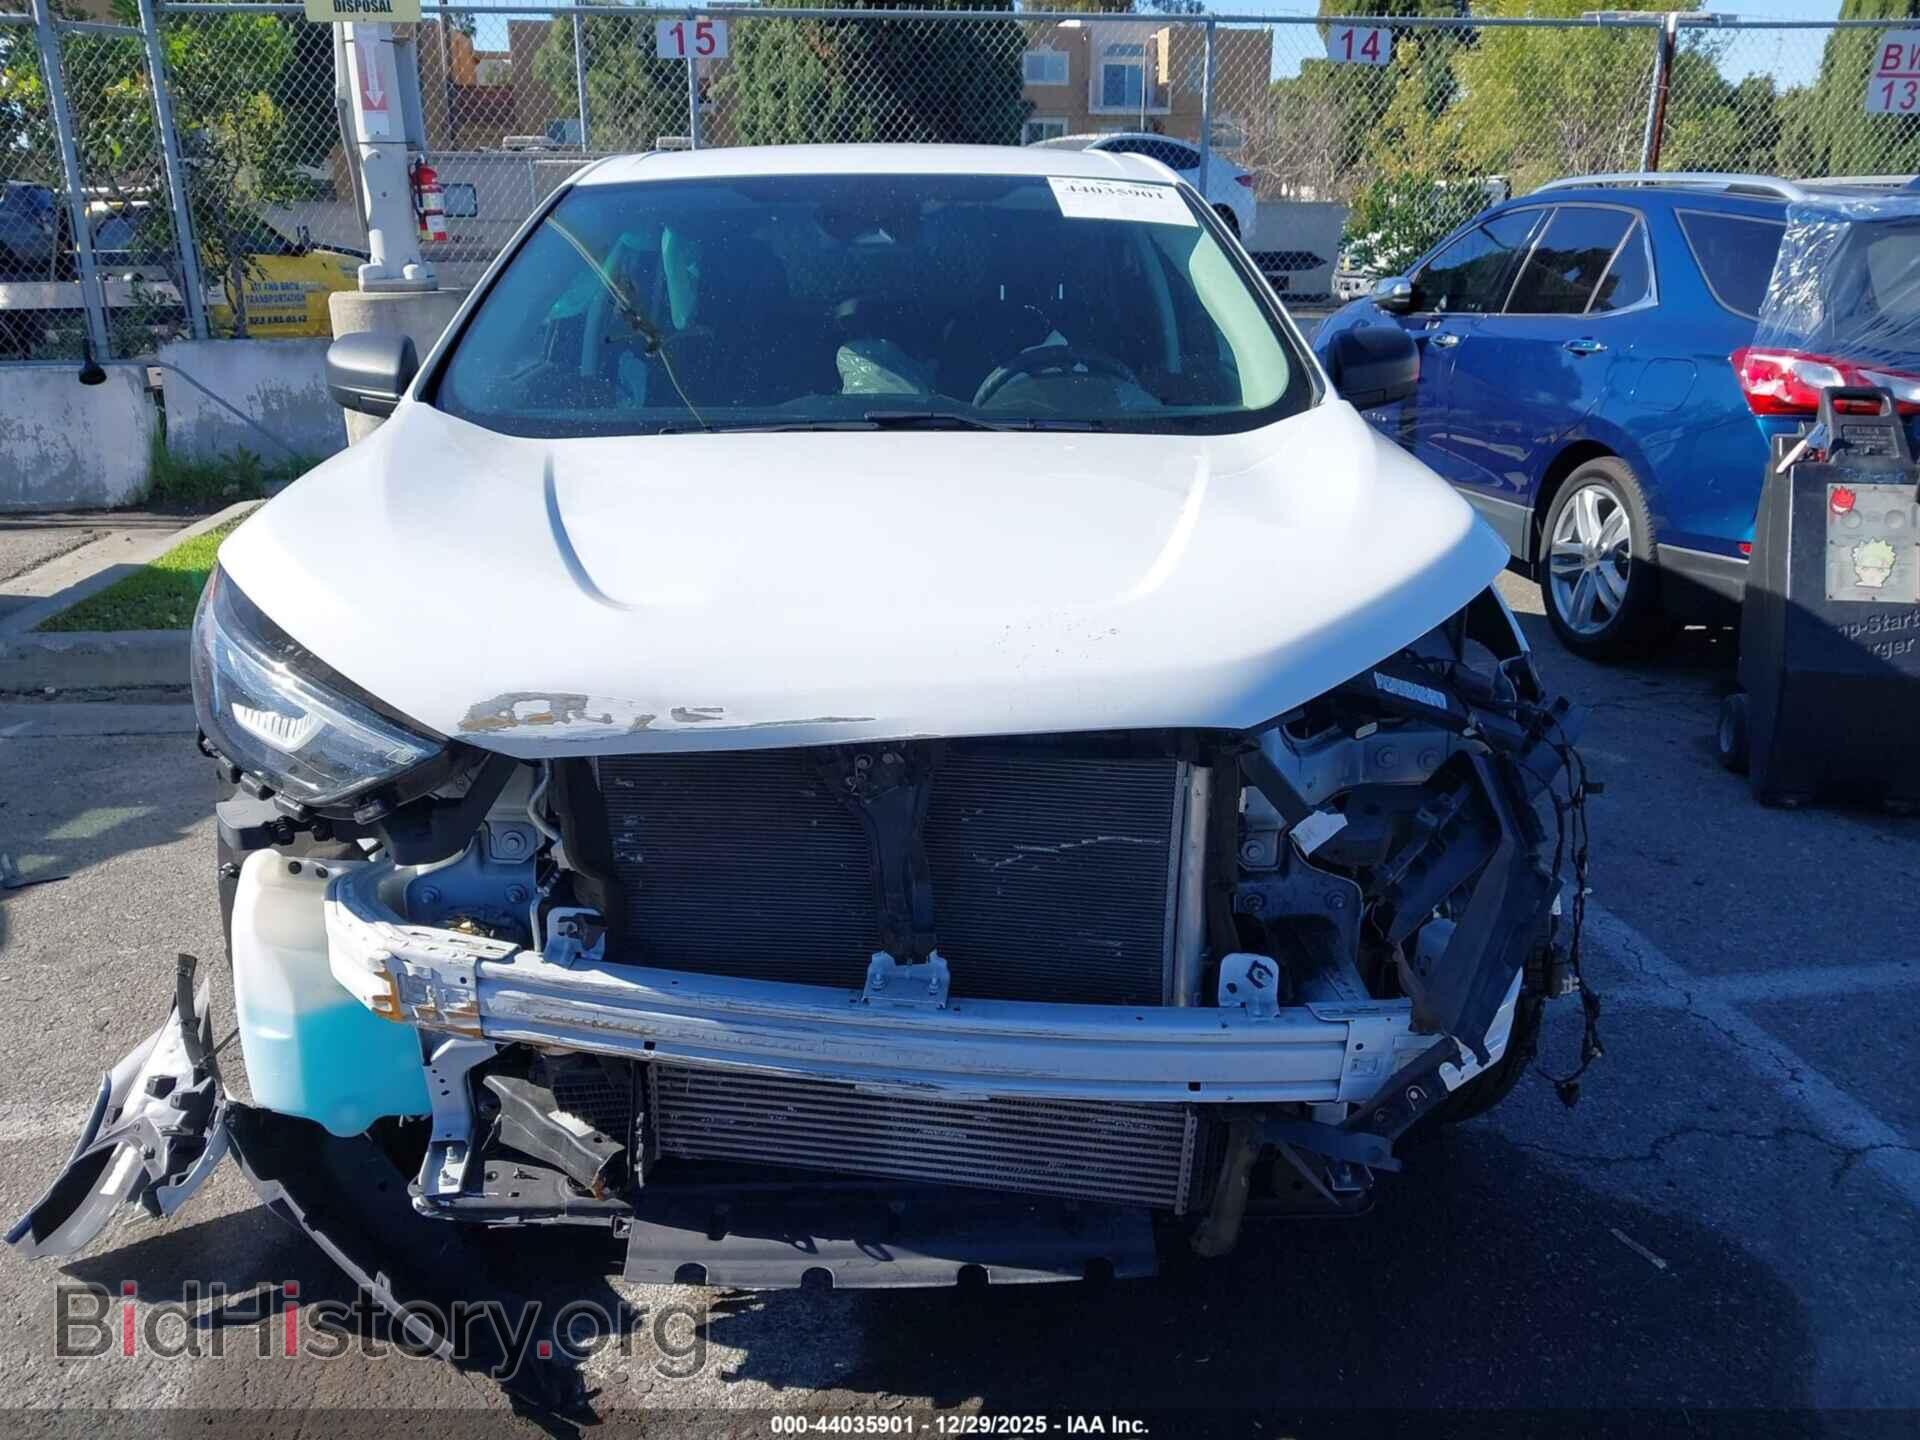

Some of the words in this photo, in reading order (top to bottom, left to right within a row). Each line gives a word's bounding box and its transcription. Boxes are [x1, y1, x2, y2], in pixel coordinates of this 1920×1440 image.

[333, 0, 393, 13] DISPOSAL
[670, 22, 716, 56] 15
[1341, 29, 1380, 61] 14
[1882, 80, 1918, 110] 13
